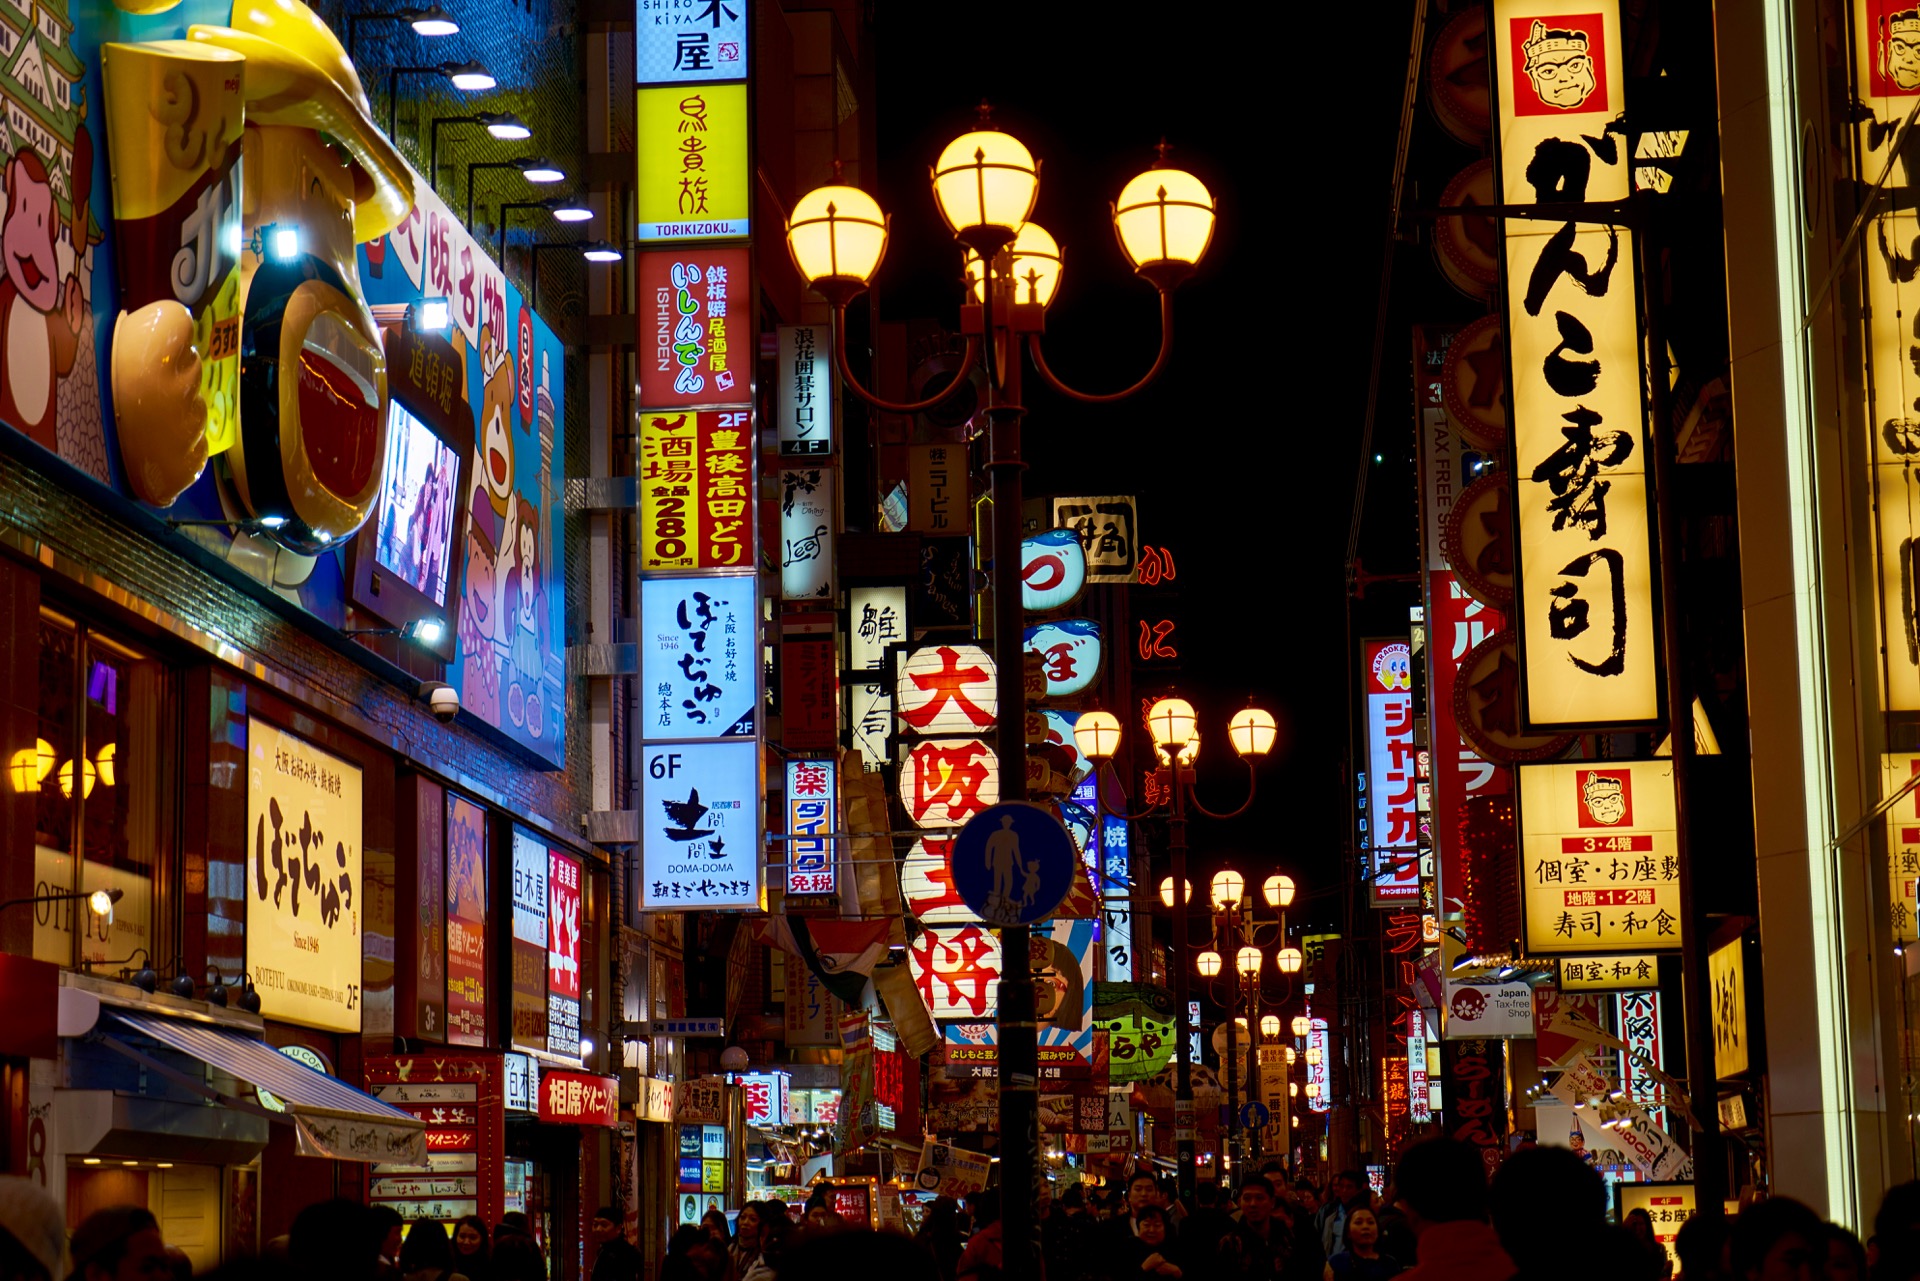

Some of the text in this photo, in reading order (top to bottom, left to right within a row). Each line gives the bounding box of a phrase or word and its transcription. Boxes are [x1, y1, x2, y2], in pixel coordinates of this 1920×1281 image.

[677, 94, 708, 214] 鳥貴族
[656, 223, 729, 236] TORIKIZOKU
[657, 287, 670, 371] ISHINDEN
[671, 262, 704, 394] いしんでん
[409, 339, 454, 415] 道頓堀
[794, 328, 815, 438] 浪花囲碁サロン
[718, 412, 747, 427] 2F
[1434, 420, 1449, 453] TAX
[643, 436, 696, 483] 酒場
[705, 429, 747, 565] 豊後高田どり
[1436, 461, 1451, 507] FREE
[655, 498, 686, 558] 280
[783, 525, 827, 567] Leaf
[657, 634, 679, 642] Since
[660, 642, 679, 650] 1946
[735, 722, 752, 734] 2F
[649, 754, 681, 779] 6F
[796, 762, 827, 795] 薬
[1385, 699, 1419, 882] ジャンカラ
[796, 801, 826, 871] ダイコク
[893, 646, 1000, 1016] 大阪王将
[514, 859, 544, 907] 白木屋
[668, 863, 733, 873] DOMA-DOMA
[790, 874, 832, 892] 免税
[652, 878, 751, 898] 朝までやってます
[293, 931, 320, 954] Since 1946
[255, 966, 285, 990] BOTEJYU
[1498, 989, 1529, 999] Japan.
[346, 983, 358, 1010] 2F
[1495, 1000, 1530, 1009] Tax-free
[1508, 1009, 1530, 1019] Shop
[549, 1078, 614, 1117] 相席ダイニング
[397, 1203, 442, 1216] 白木屋
